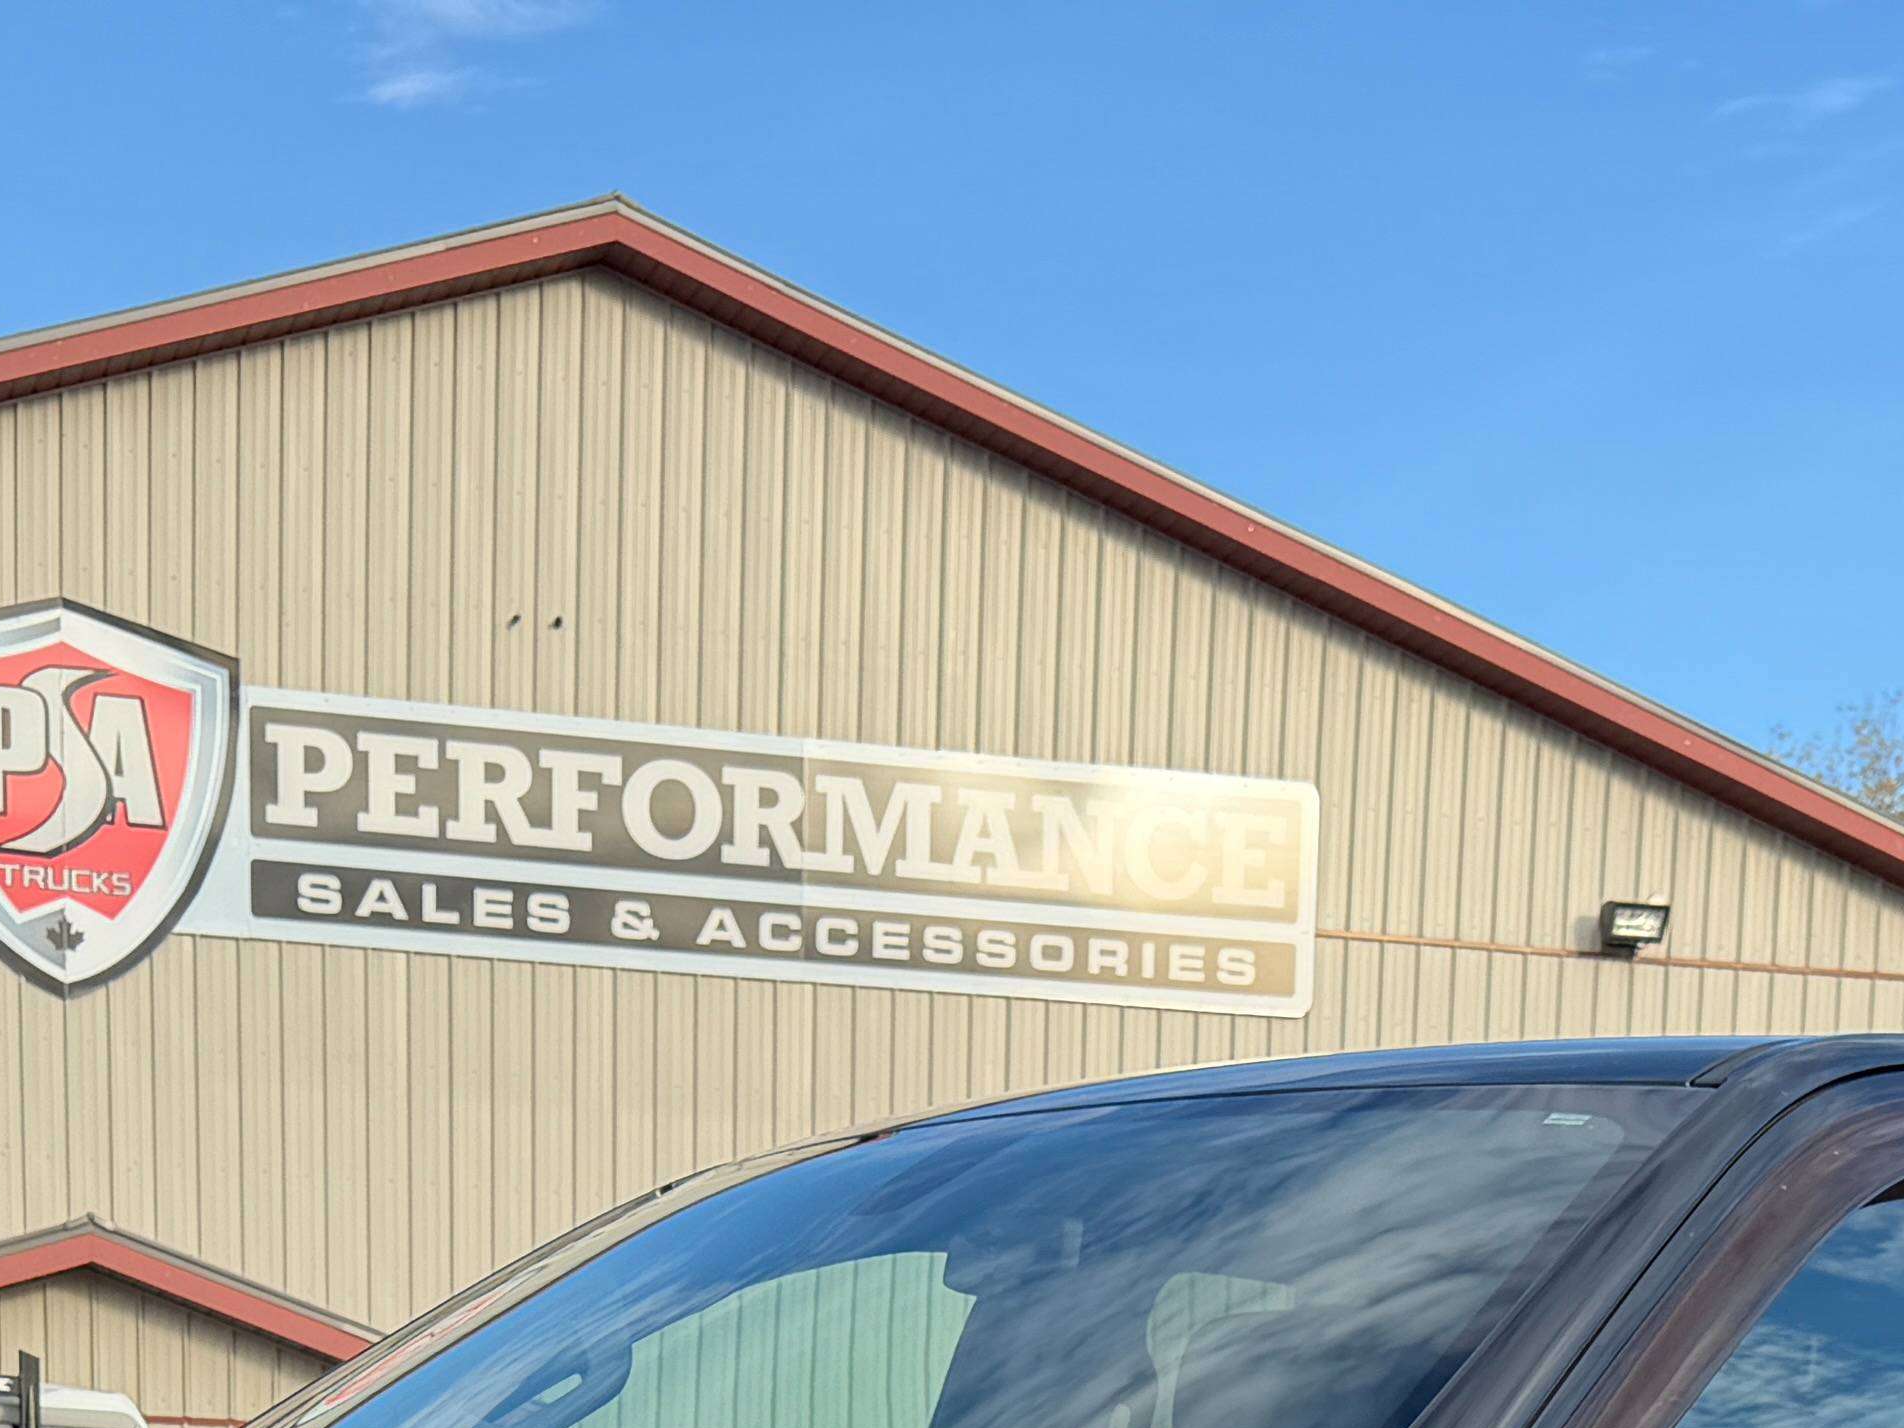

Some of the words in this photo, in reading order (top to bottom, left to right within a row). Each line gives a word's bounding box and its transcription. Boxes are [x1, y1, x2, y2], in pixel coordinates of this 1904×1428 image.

[264, 722, 1288, 909] PERFORMANCE
[296, 872, 571, 935] SALES
[609, 900, 661, 942] &
[695, 907, 1257, 987] ACCESSORIES
